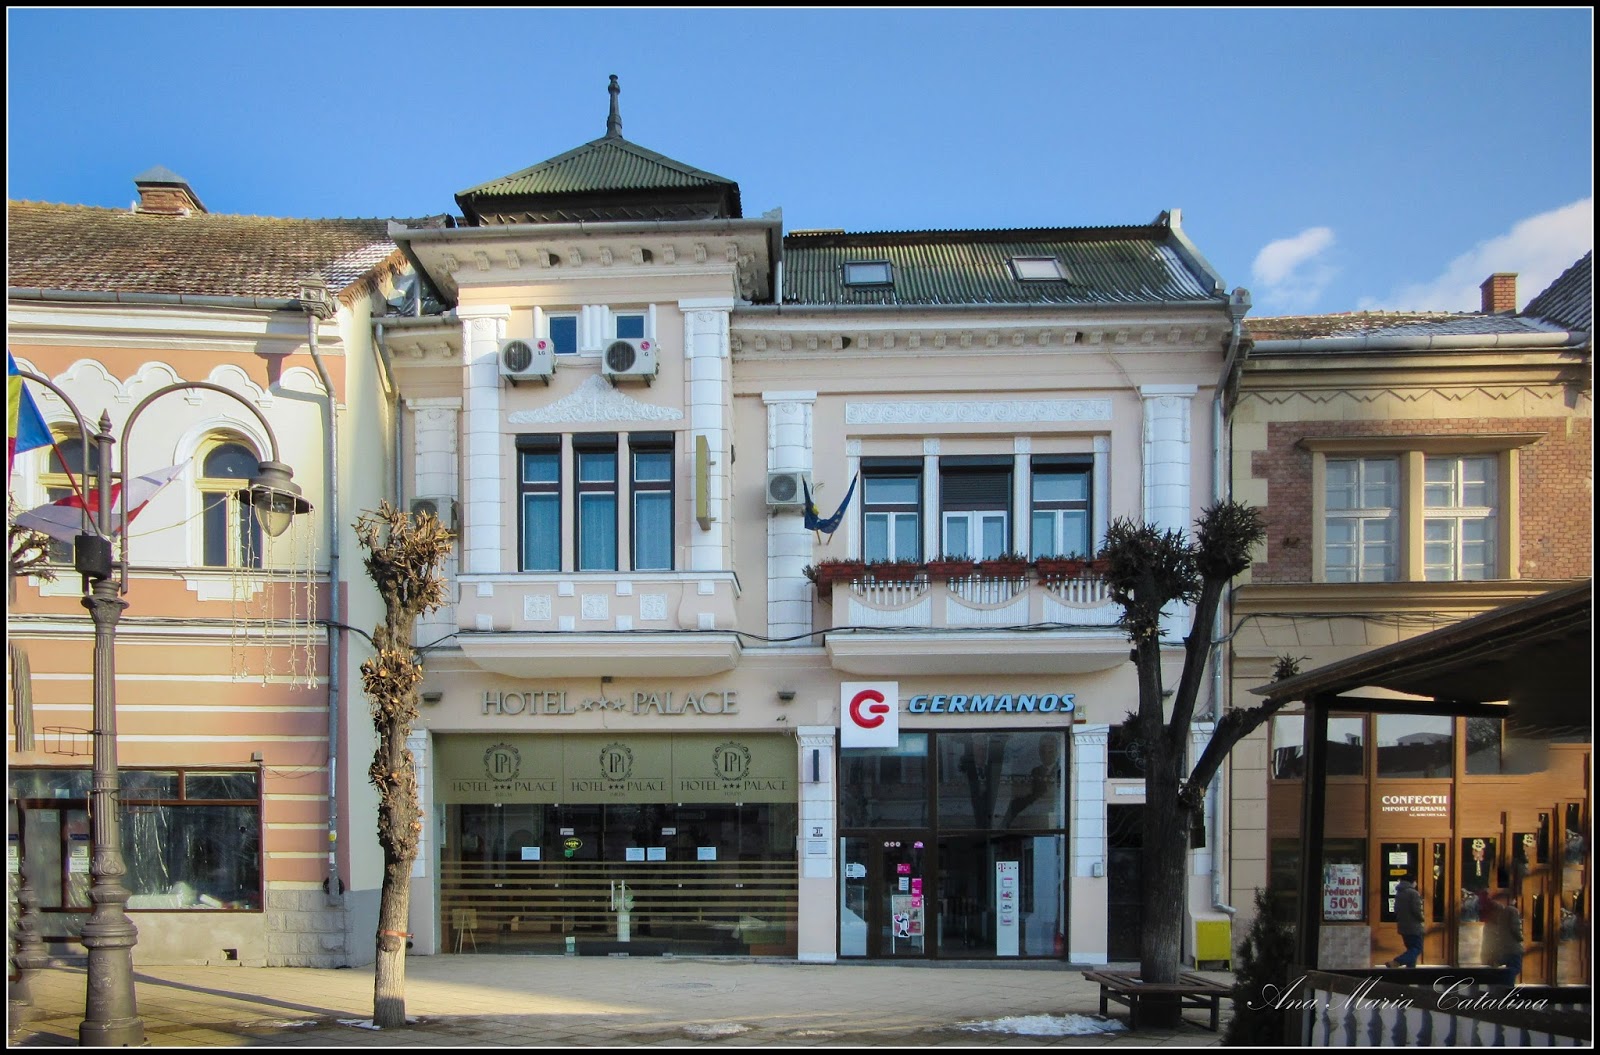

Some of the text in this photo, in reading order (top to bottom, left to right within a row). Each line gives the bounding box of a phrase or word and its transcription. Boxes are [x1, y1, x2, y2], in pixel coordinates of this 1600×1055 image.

[481, 690, 739, 715] HOTEL PALACE
[908, 693, 1076, 714] GERMANOS
[452, 781, 558, 792] HOTEL PALACE
[571, 781, 666, 792] HOTEL PALACE
[680, 780, 789, 791] HOTEL PALACE
[1381, 795, 1448, 805] CONFECTII
[1337, 876, 1360, 886] Mari
[1324, 886, 1362, 897] reduceri
[1330, 897, 1359, 909] 50%
